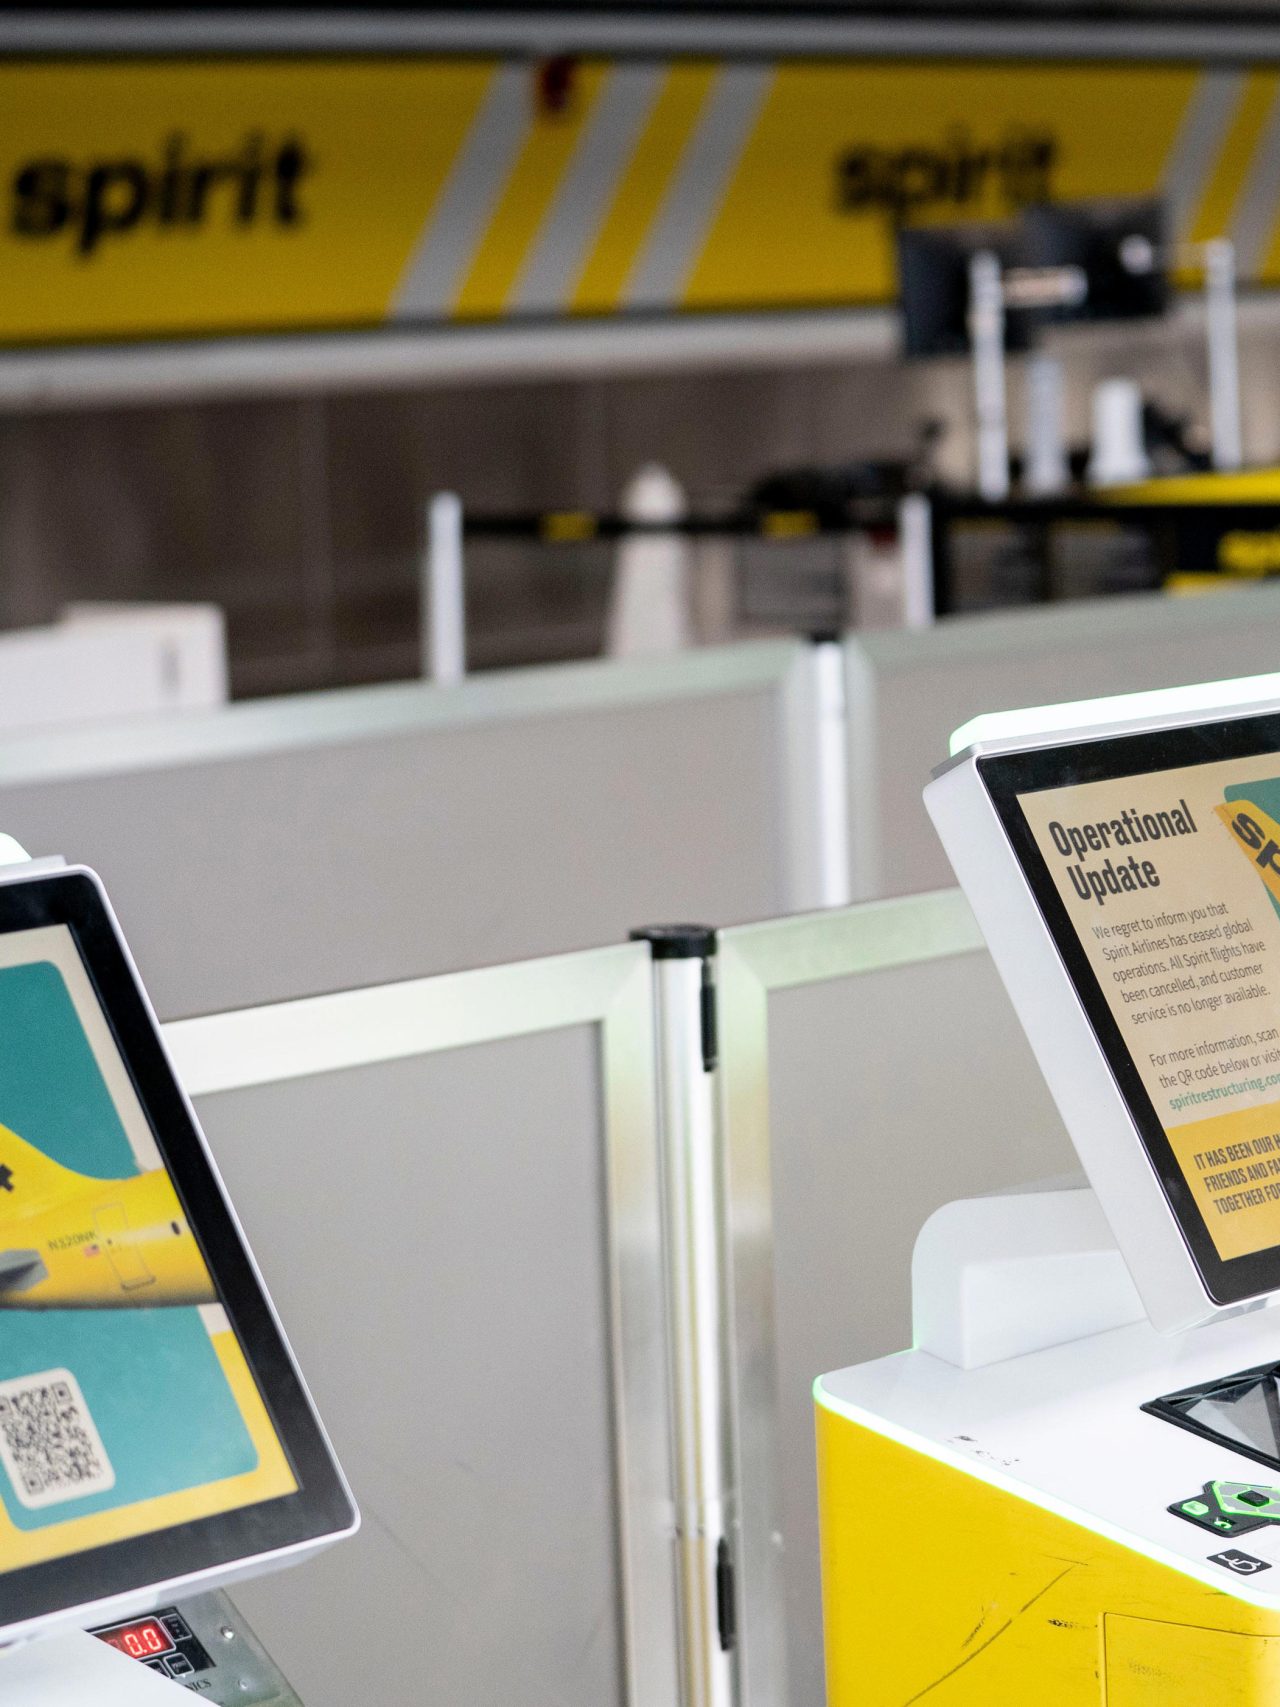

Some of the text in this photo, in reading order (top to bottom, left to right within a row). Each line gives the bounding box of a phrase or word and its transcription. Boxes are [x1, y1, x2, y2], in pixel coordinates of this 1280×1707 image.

[12, 128, 306, 258] spirit
[1049, 799, 1198, 862] Operational
[1066, 856, 1160, 905] Update
[1092, 903, 1229, 940] We regret to inform you that
[1103, 918, 1253, 962] Spirit Airlines has ceased global
[1112, 940, 1267, 985] operations. All Spirit flights have
[1120, 963, 1264, 1004] been cancelled, and customer
[1131, 984, 1271, 1025] service is no longer available.
[1149, 1027, 1280, 1067] For more information, scan
[1159, 1075, 1177, 1089] the
[1177, 1068, 1194, 1086] QR
[1194, 1063, 1219, 1081] code
[1218, 1057, 1251, 1074] below
[1250, 1054, 1262, 1067] or
[1193, 1154, 1207, 1170] IT
[1206, 1149, 1228, 1167] HAS
[1225, 1141, 1254, 1164] BEEN
[1252, 1135, 1275, 1154] OUR
[1203, 1165, 1248, 1193] FRIENDS
[1247, 1161, 1270, 1181] AND
[1213, 1189, 1264, 1216] TOGETHER
